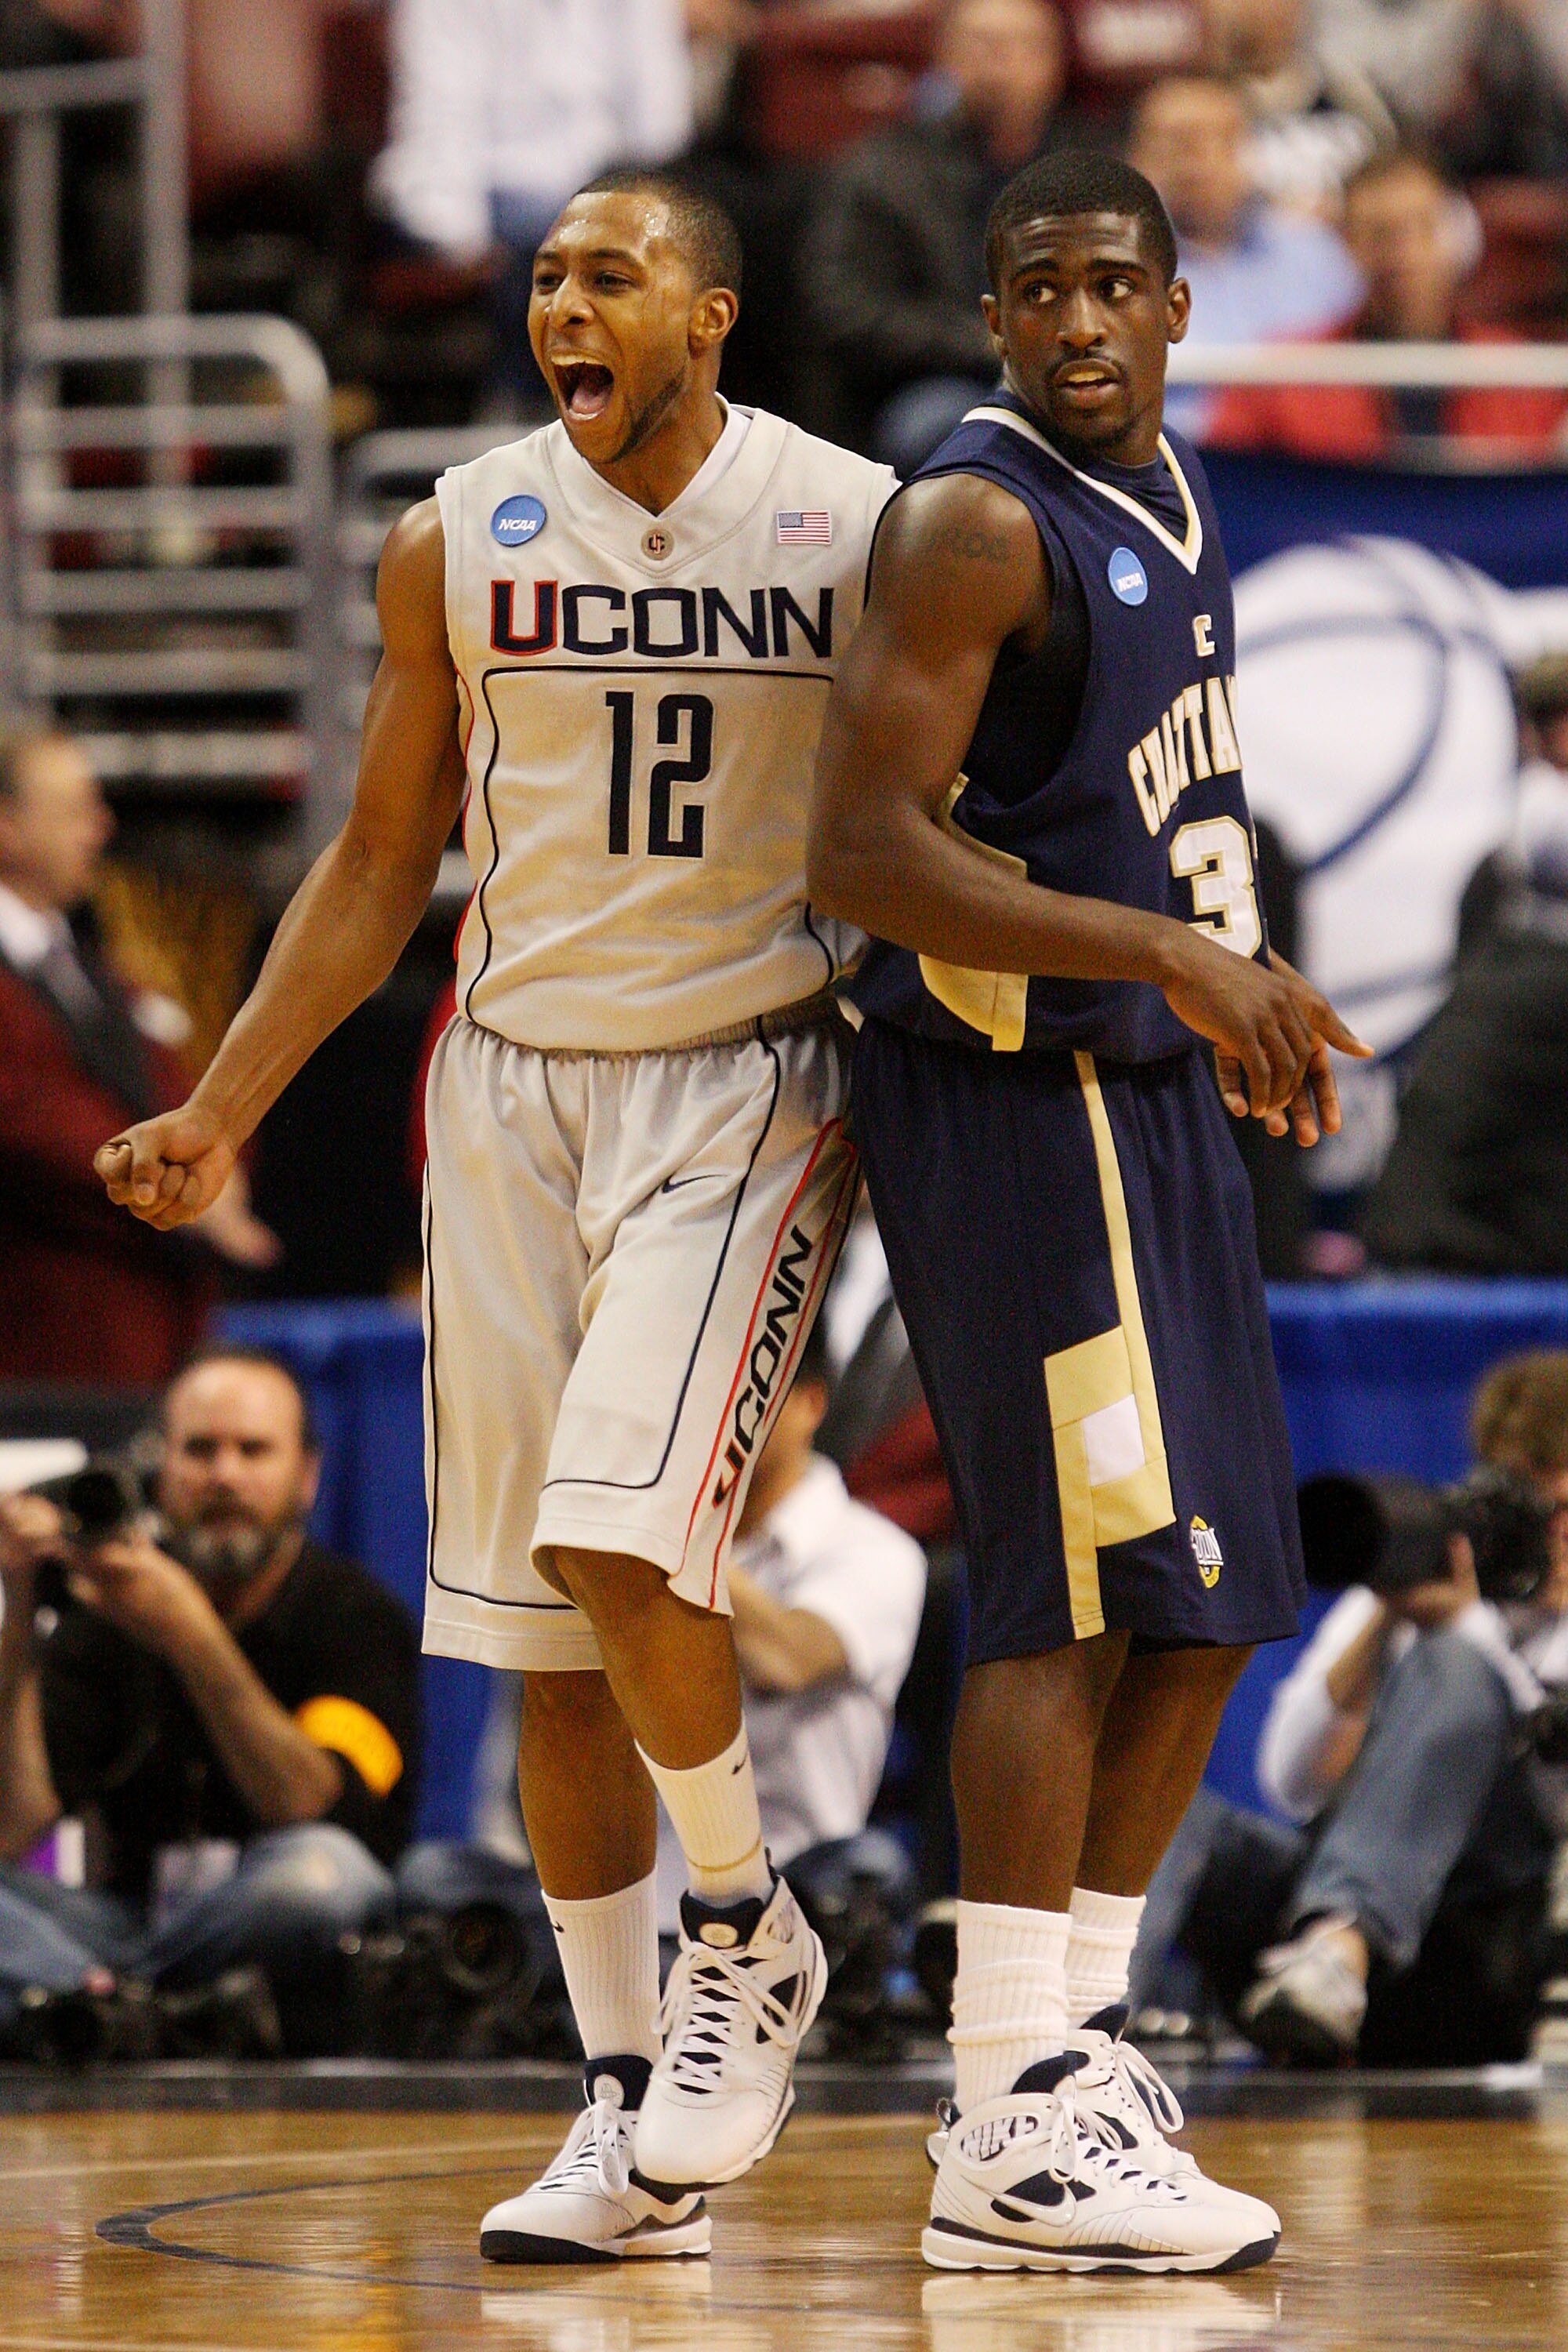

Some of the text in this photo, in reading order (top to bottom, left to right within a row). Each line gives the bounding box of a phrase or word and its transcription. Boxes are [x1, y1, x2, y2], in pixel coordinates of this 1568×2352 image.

[498, 518, 537, 531] NCAA
[1116, 572, 1143, 592] NCAA
[490, 579, 833, 657] UCONN
[1194, 614, 1215, 657] C
[605, 691, 714, 858] 12
[712, 1225, 812, 1508] UCONN
